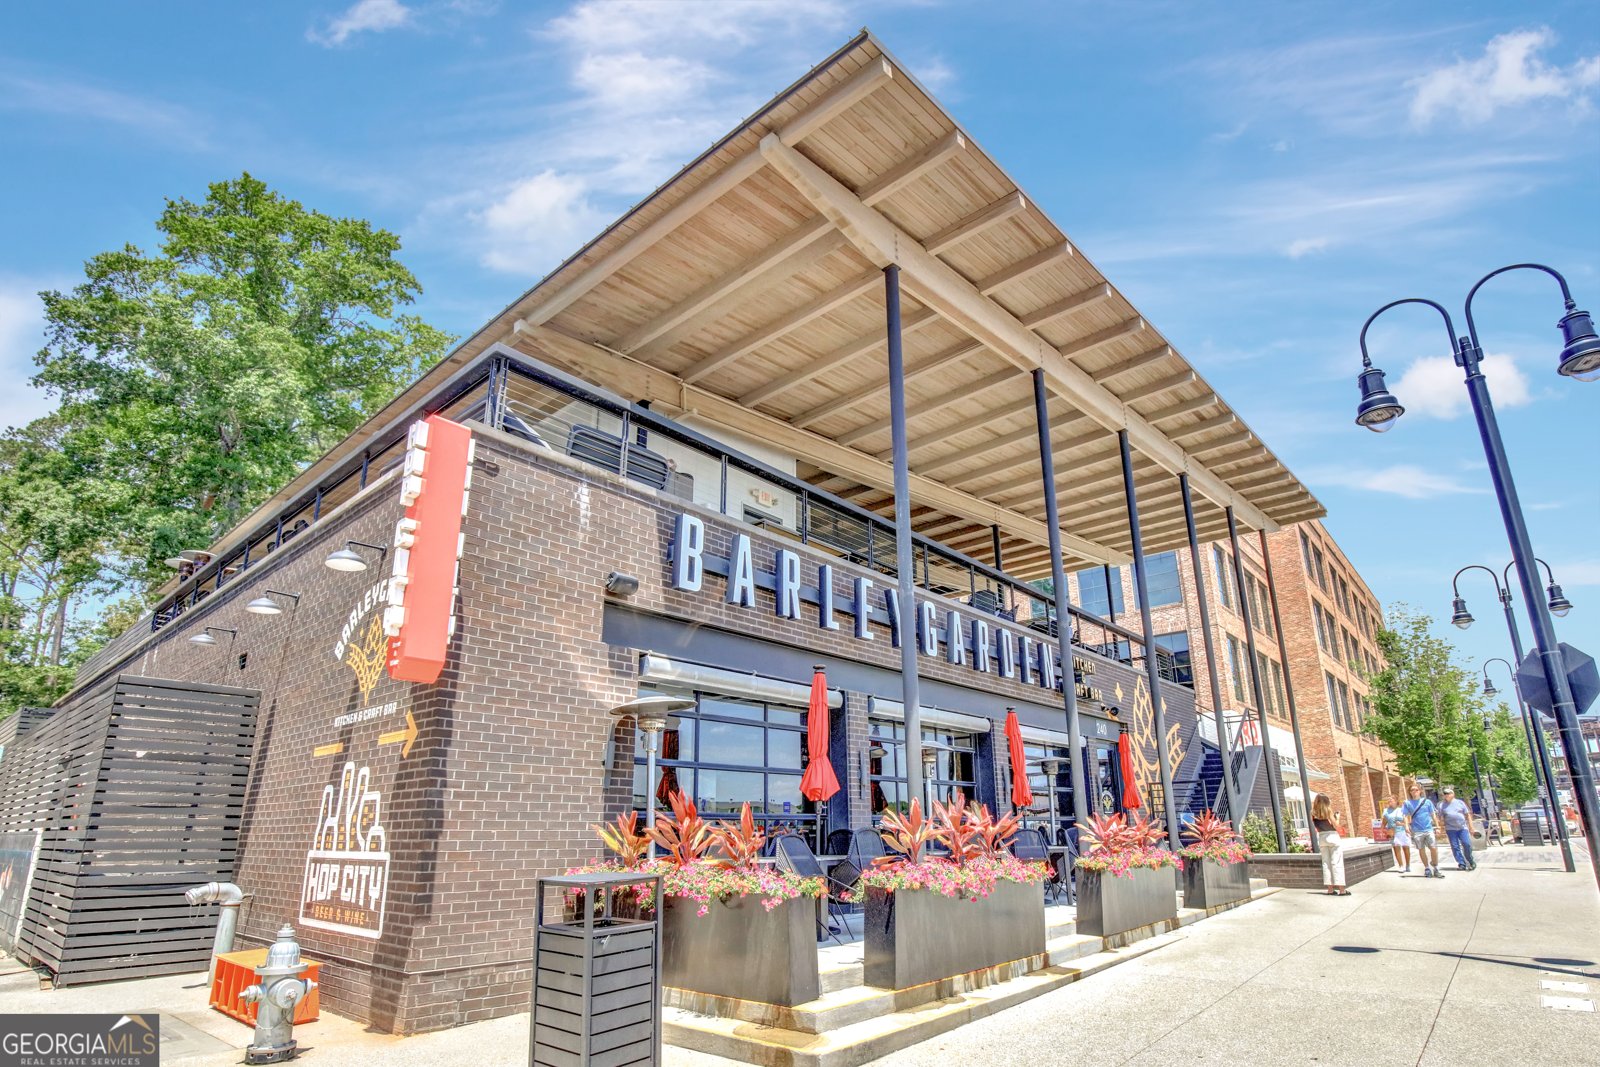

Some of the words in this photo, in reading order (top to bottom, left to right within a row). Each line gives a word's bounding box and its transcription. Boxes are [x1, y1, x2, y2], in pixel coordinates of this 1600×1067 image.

[334, 579, 389, 660] BARLEYG
[1073, 656, 1095, 672] ITCHEN
[334, 712, 358, 728] KITCHEN
[363, 705, 383, 721] CRAFT
[383, 702, 397, 716] BAR
[1096, 722, 1107, 735] 240
[306, 863, 340, 902] HOP
[340, 865, 383, 911] CITY
[314, 905, 333, 919] BEER
[344, 910, 365, 925] WINE
